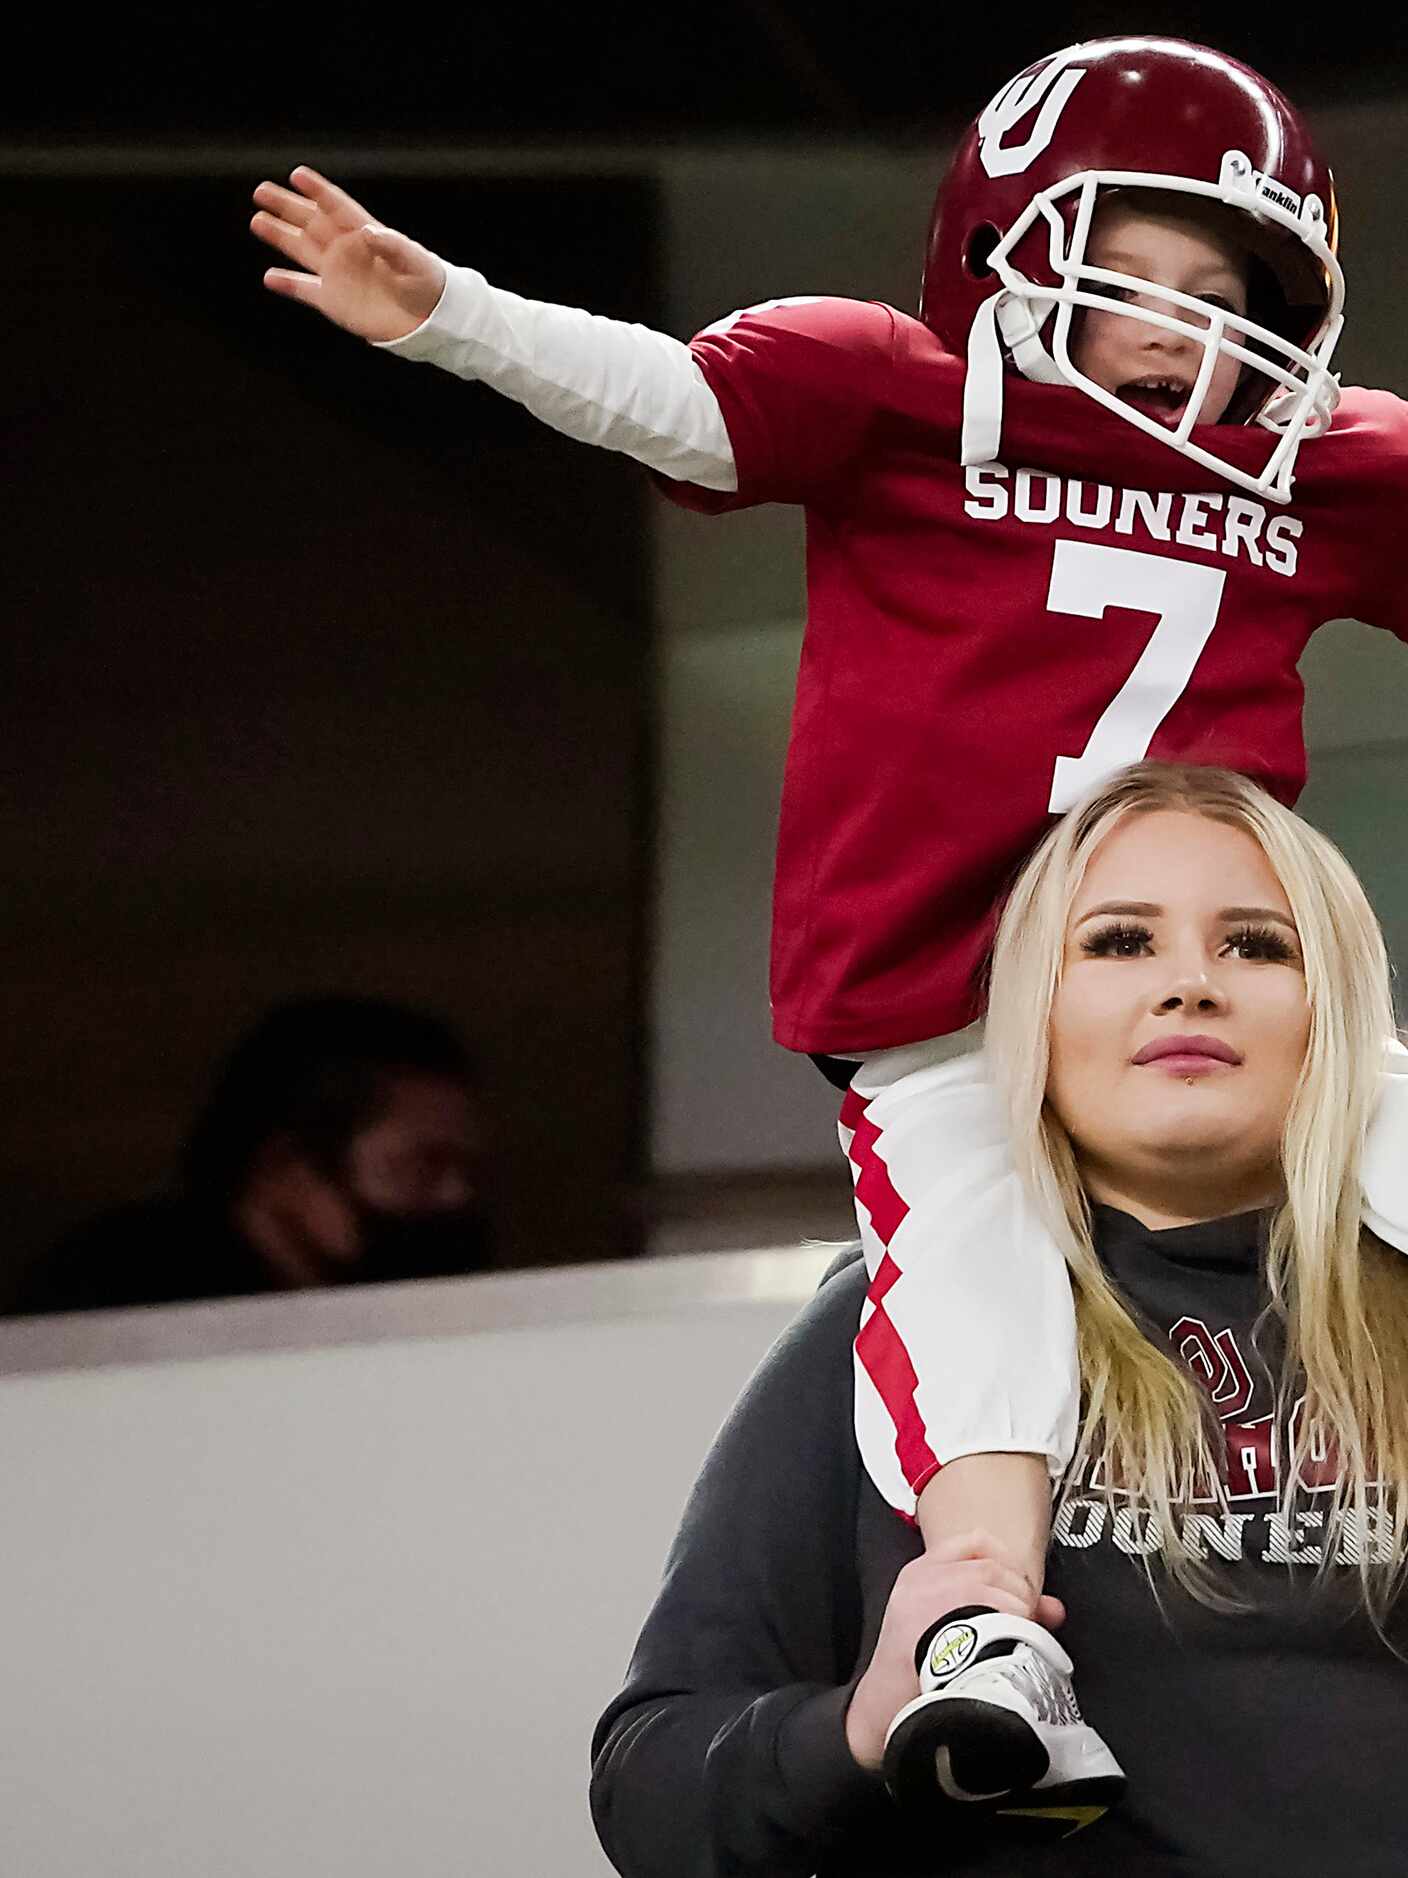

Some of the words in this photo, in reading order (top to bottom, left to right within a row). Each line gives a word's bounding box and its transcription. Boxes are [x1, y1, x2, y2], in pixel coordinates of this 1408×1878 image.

[1256, 177, 1298, 215] anklin
[963, 463, 1303, 577] SOONERS
[1046, 539, 1227, 814] 7
